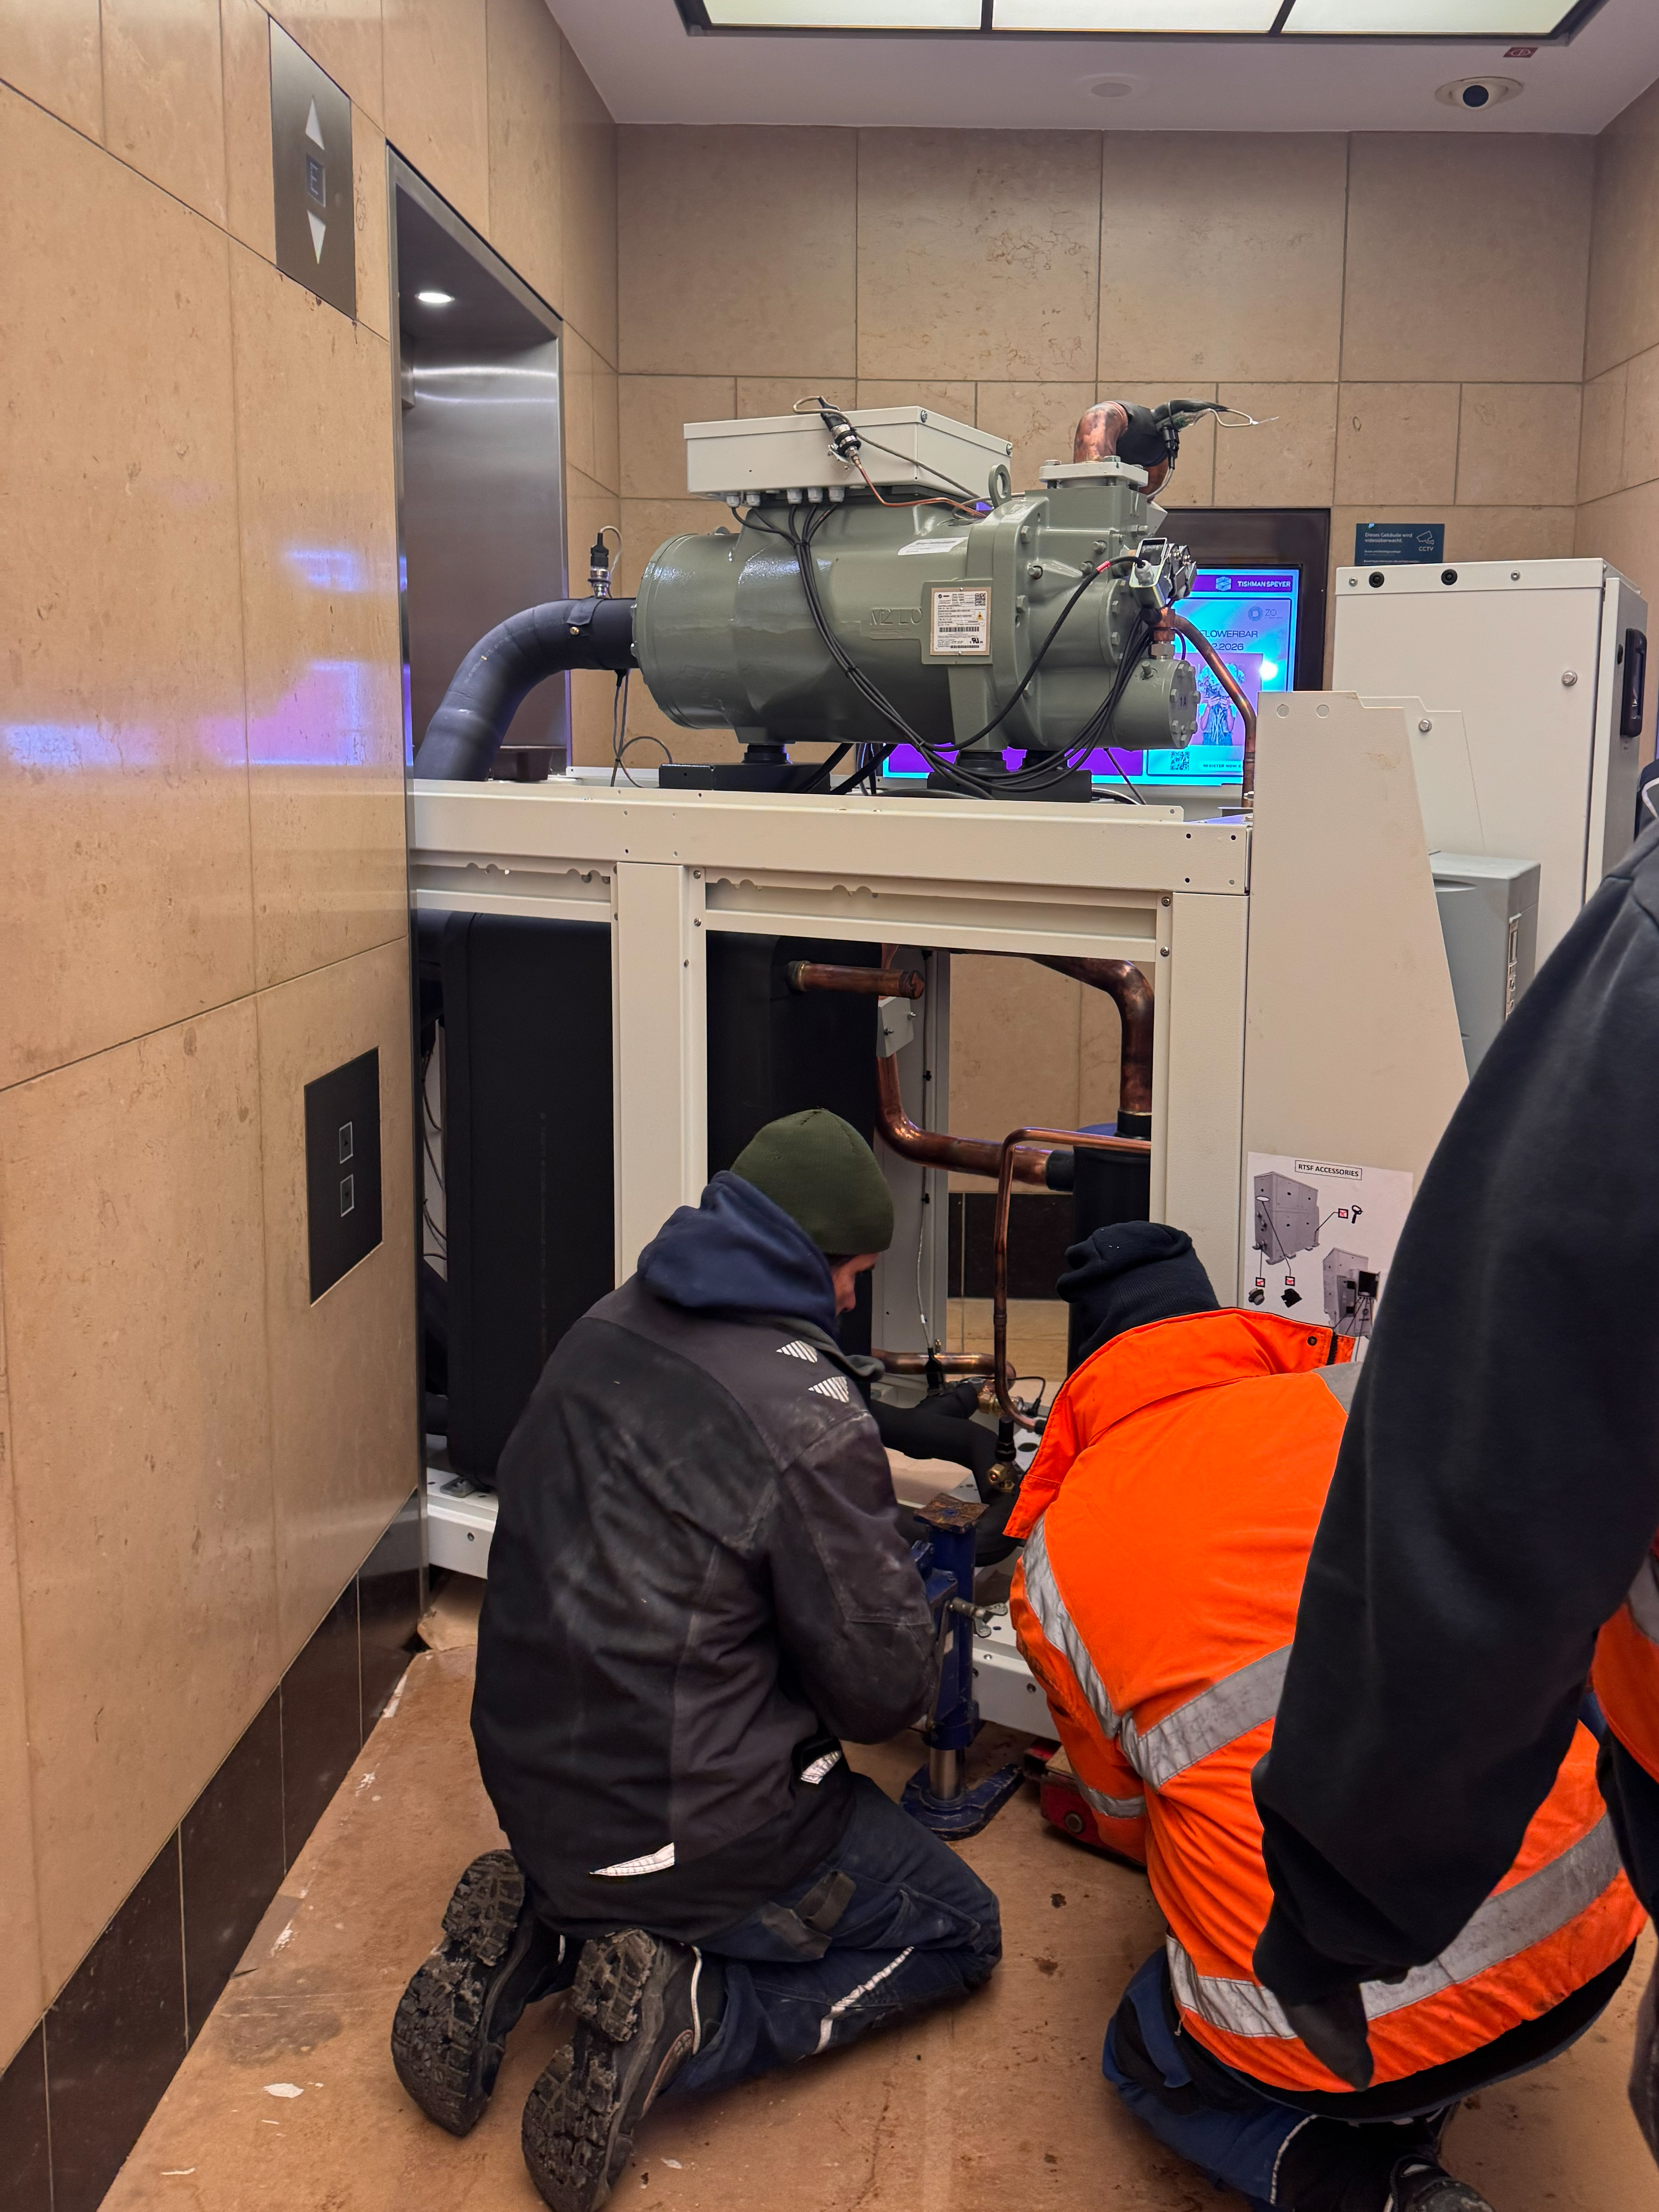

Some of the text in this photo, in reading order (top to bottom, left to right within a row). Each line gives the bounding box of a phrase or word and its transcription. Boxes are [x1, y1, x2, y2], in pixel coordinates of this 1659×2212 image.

[310, 162, 319, 195] E
[1180, 696, 1187, 707] 1A
[1315, 1166, 1359, 1177] ACCESSORIES
